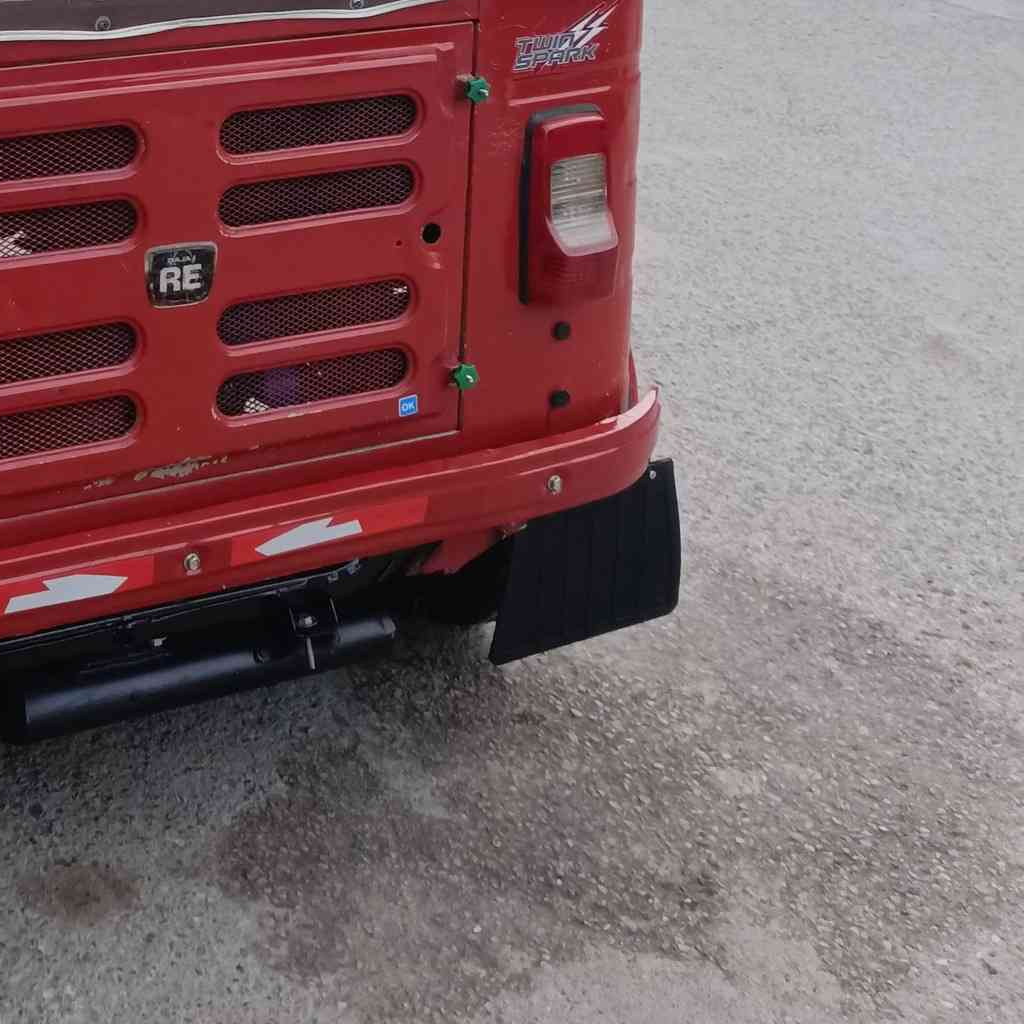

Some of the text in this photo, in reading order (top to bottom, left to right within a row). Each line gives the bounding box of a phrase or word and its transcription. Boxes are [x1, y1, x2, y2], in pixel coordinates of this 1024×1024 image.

[515, 31, 577, 55] TWIN
[512, 43, 599, 72] SPARK
[159, 263, 203, 293] RE
[401, 401, 416, 413] OK
